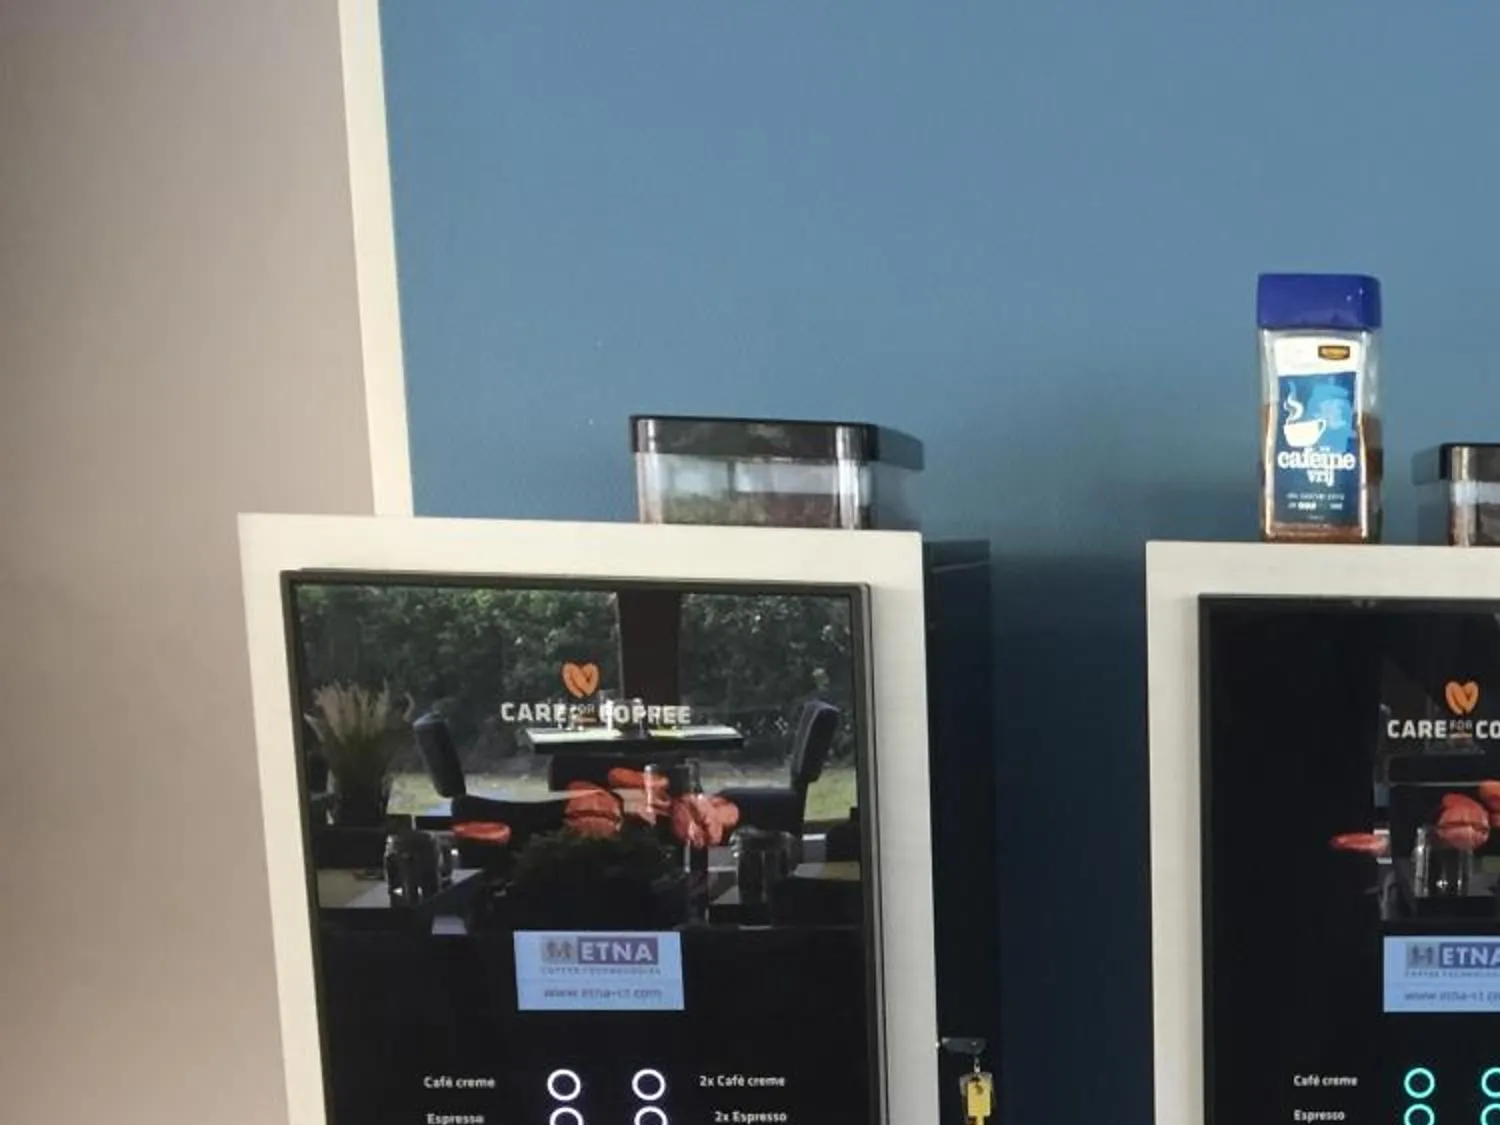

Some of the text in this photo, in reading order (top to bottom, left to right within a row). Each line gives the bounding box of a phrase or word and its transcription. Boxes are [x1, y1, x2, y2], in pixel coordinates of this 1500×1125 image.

[501, 702, 568, 722] CARE
[1386, 718, 1448, 740] CARE
[580, 940, 653, 962] ETNA
[699, 1074, 715, 1087] 2x
[714, 1110, 788, 1125] 2x Espresso
[1293, 1108, 1346, 1124] Espresso
